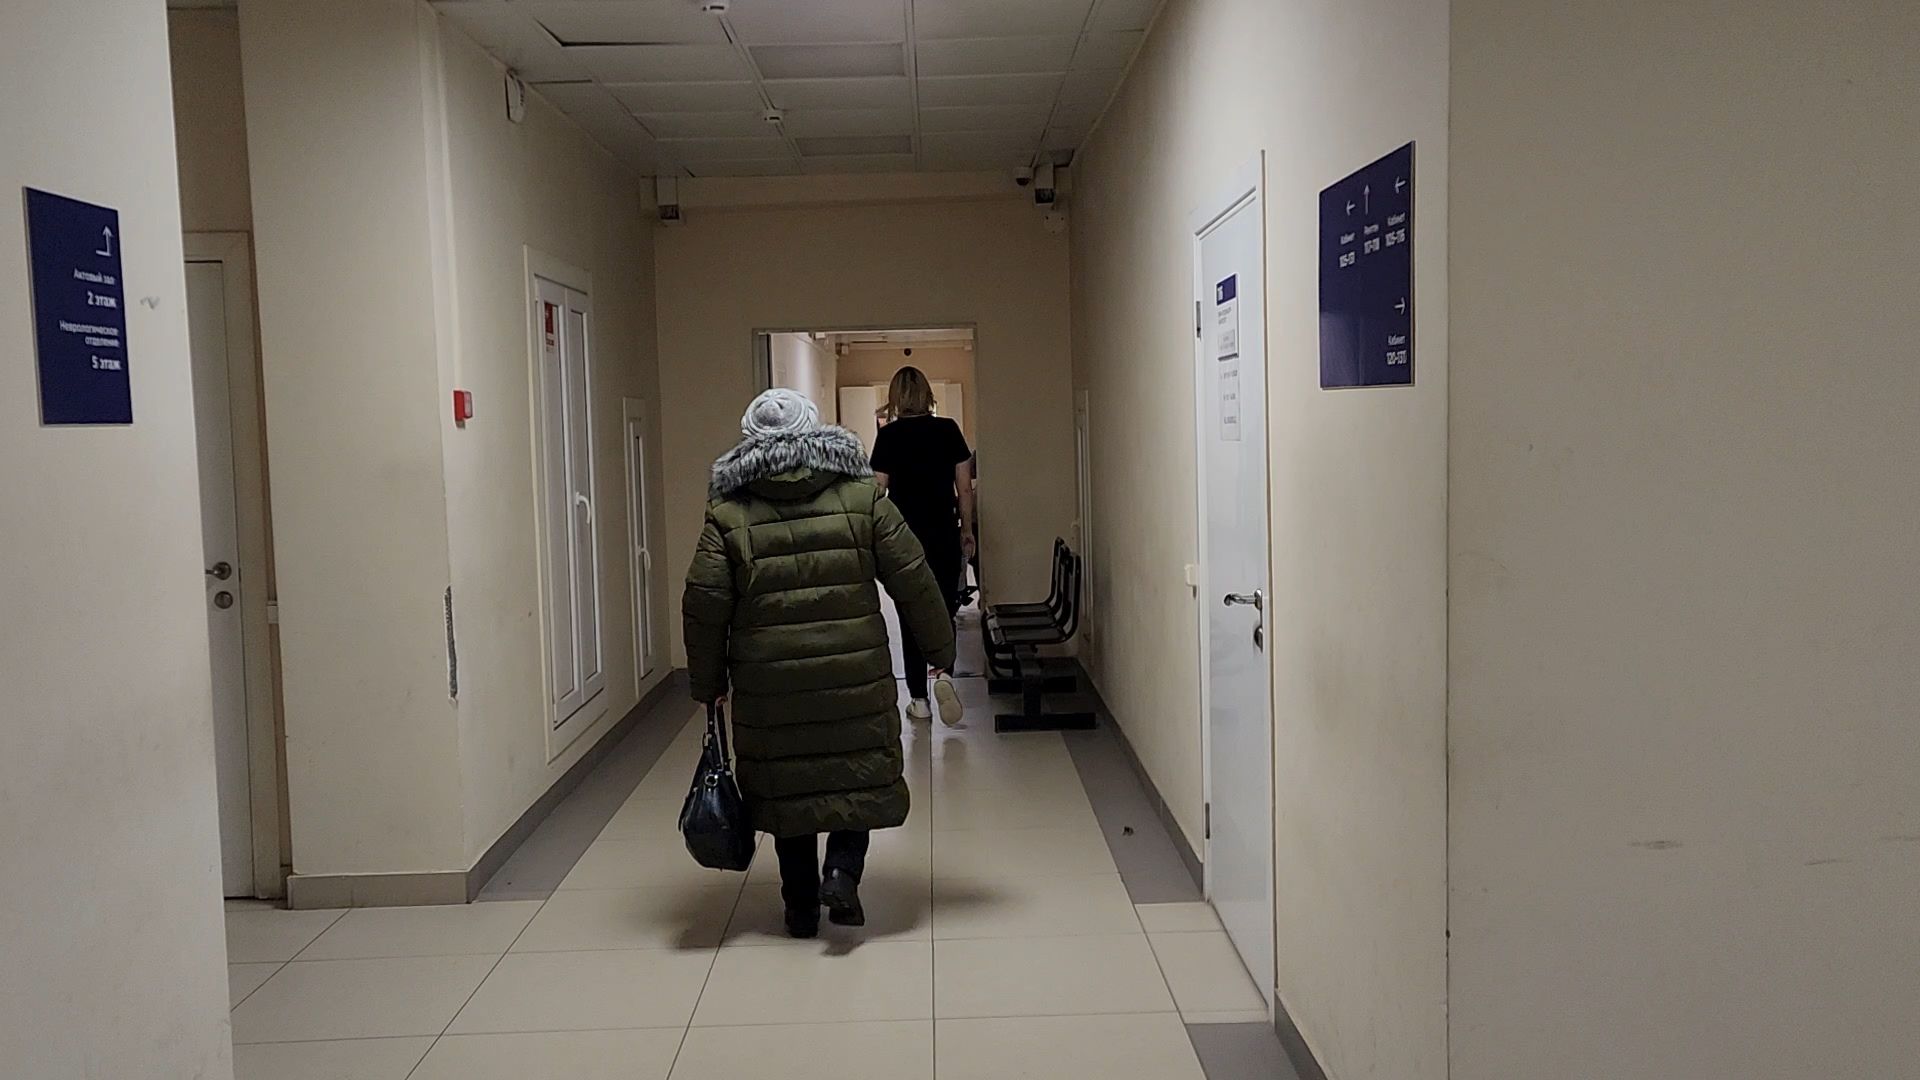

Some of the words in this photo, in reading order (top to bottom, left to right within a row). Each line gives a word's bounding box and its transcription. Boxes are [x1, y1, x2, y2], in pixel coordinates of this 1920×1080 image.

[74, 268, 102, 282] Актовый
[87, 291, 94, 305] 2
[95, 295, 117, 308] этаж
[92, 355, 98, 369] 5
[99, 358, 121, 370] этаж
